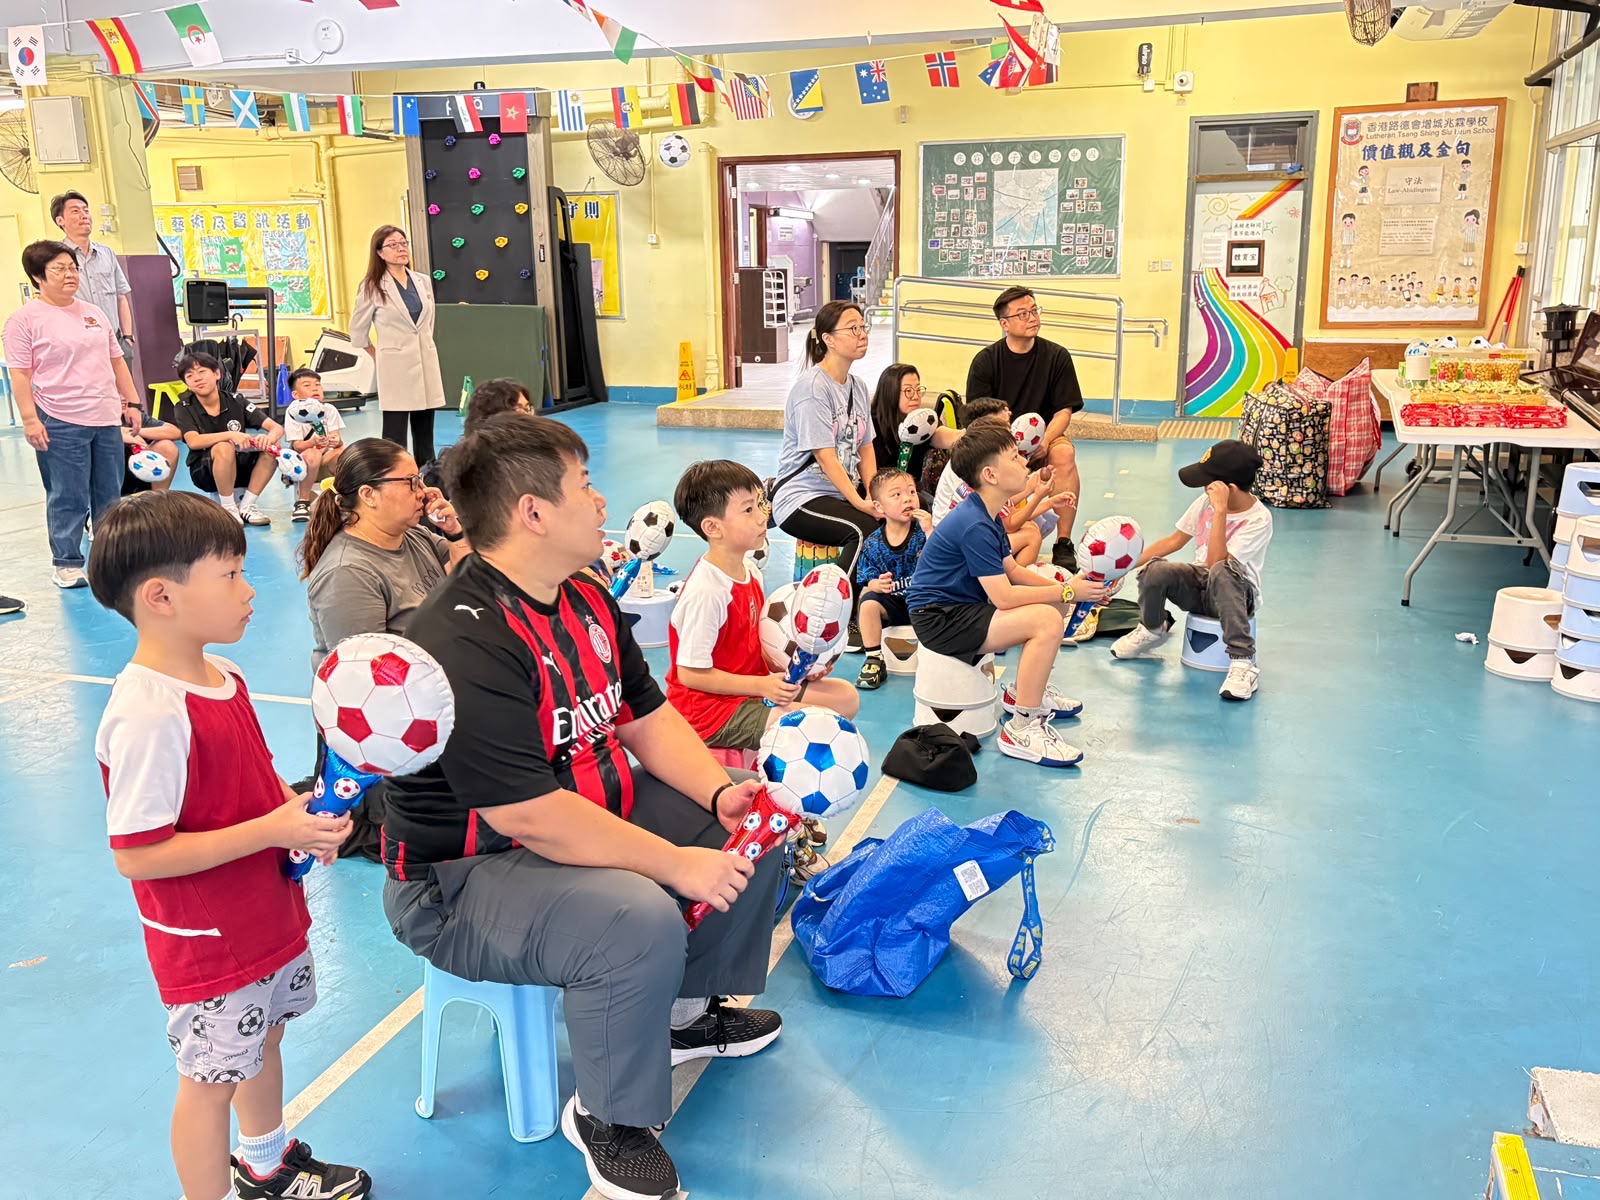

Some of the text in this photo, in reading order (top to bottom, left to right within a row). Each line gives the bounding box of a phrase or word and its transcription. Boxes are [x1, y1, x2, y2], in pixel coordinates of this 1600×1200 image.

[1366, 132, 1396, 140] Lutheran
[1398, 130, 1418, 139] Tsang
[1420, 129, 1440, 138] Shing
[1441, 128, 1452, 136] Siu
[1473, 127, 1495, 135] Schoo
[1362, 140, 1471, 161] 價值觀及金句
[552, 677, 623, 746] Emirate
